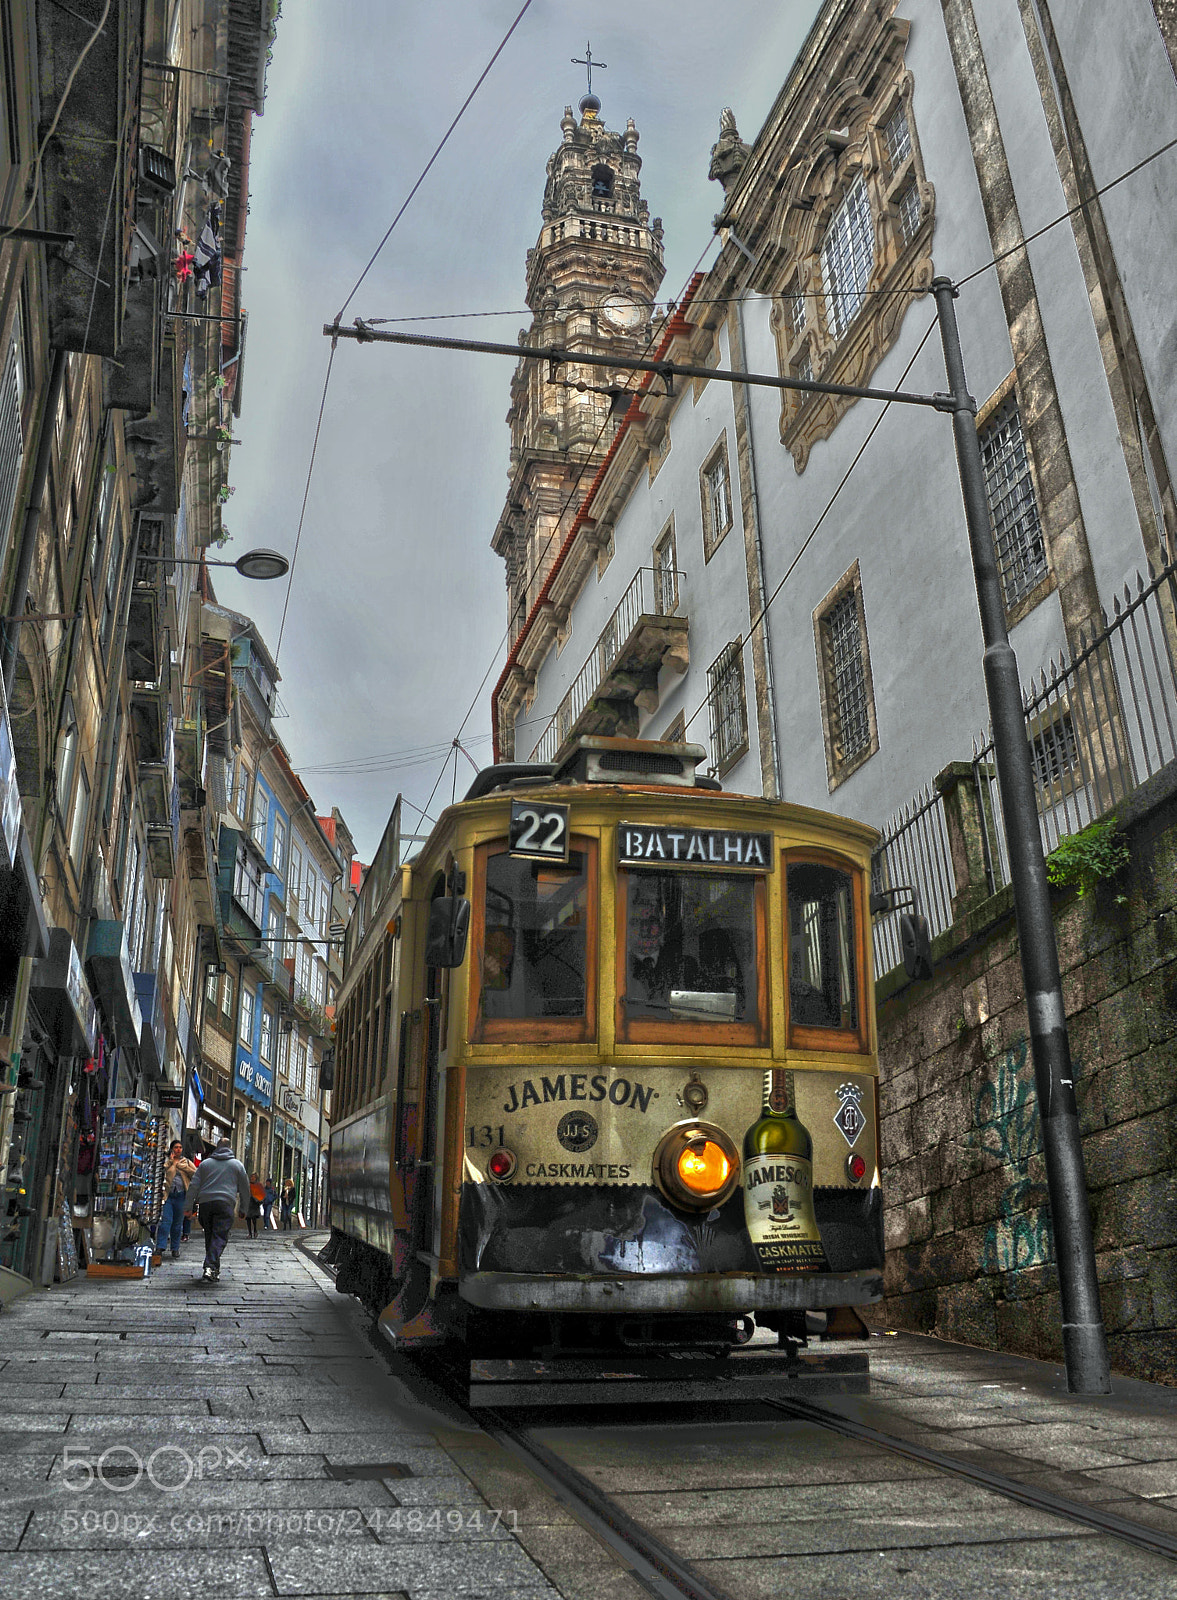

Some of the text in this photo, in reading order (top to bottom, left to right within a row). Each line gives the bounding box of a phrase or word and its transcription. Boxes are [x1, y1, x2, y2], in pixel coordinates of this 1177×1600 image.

[515, 810, 566, 853] 22
[625, 831, 766, 864] BATALHA
[239, 1060, 253, 1083] arte
[504, 1074, 655, 1113] JAMESON
[468, 1125, 505, 1147] 131
[526, 1163, 631, 1179] CASKMATES
[759, 1244, 824, 1258] CASKMATES
